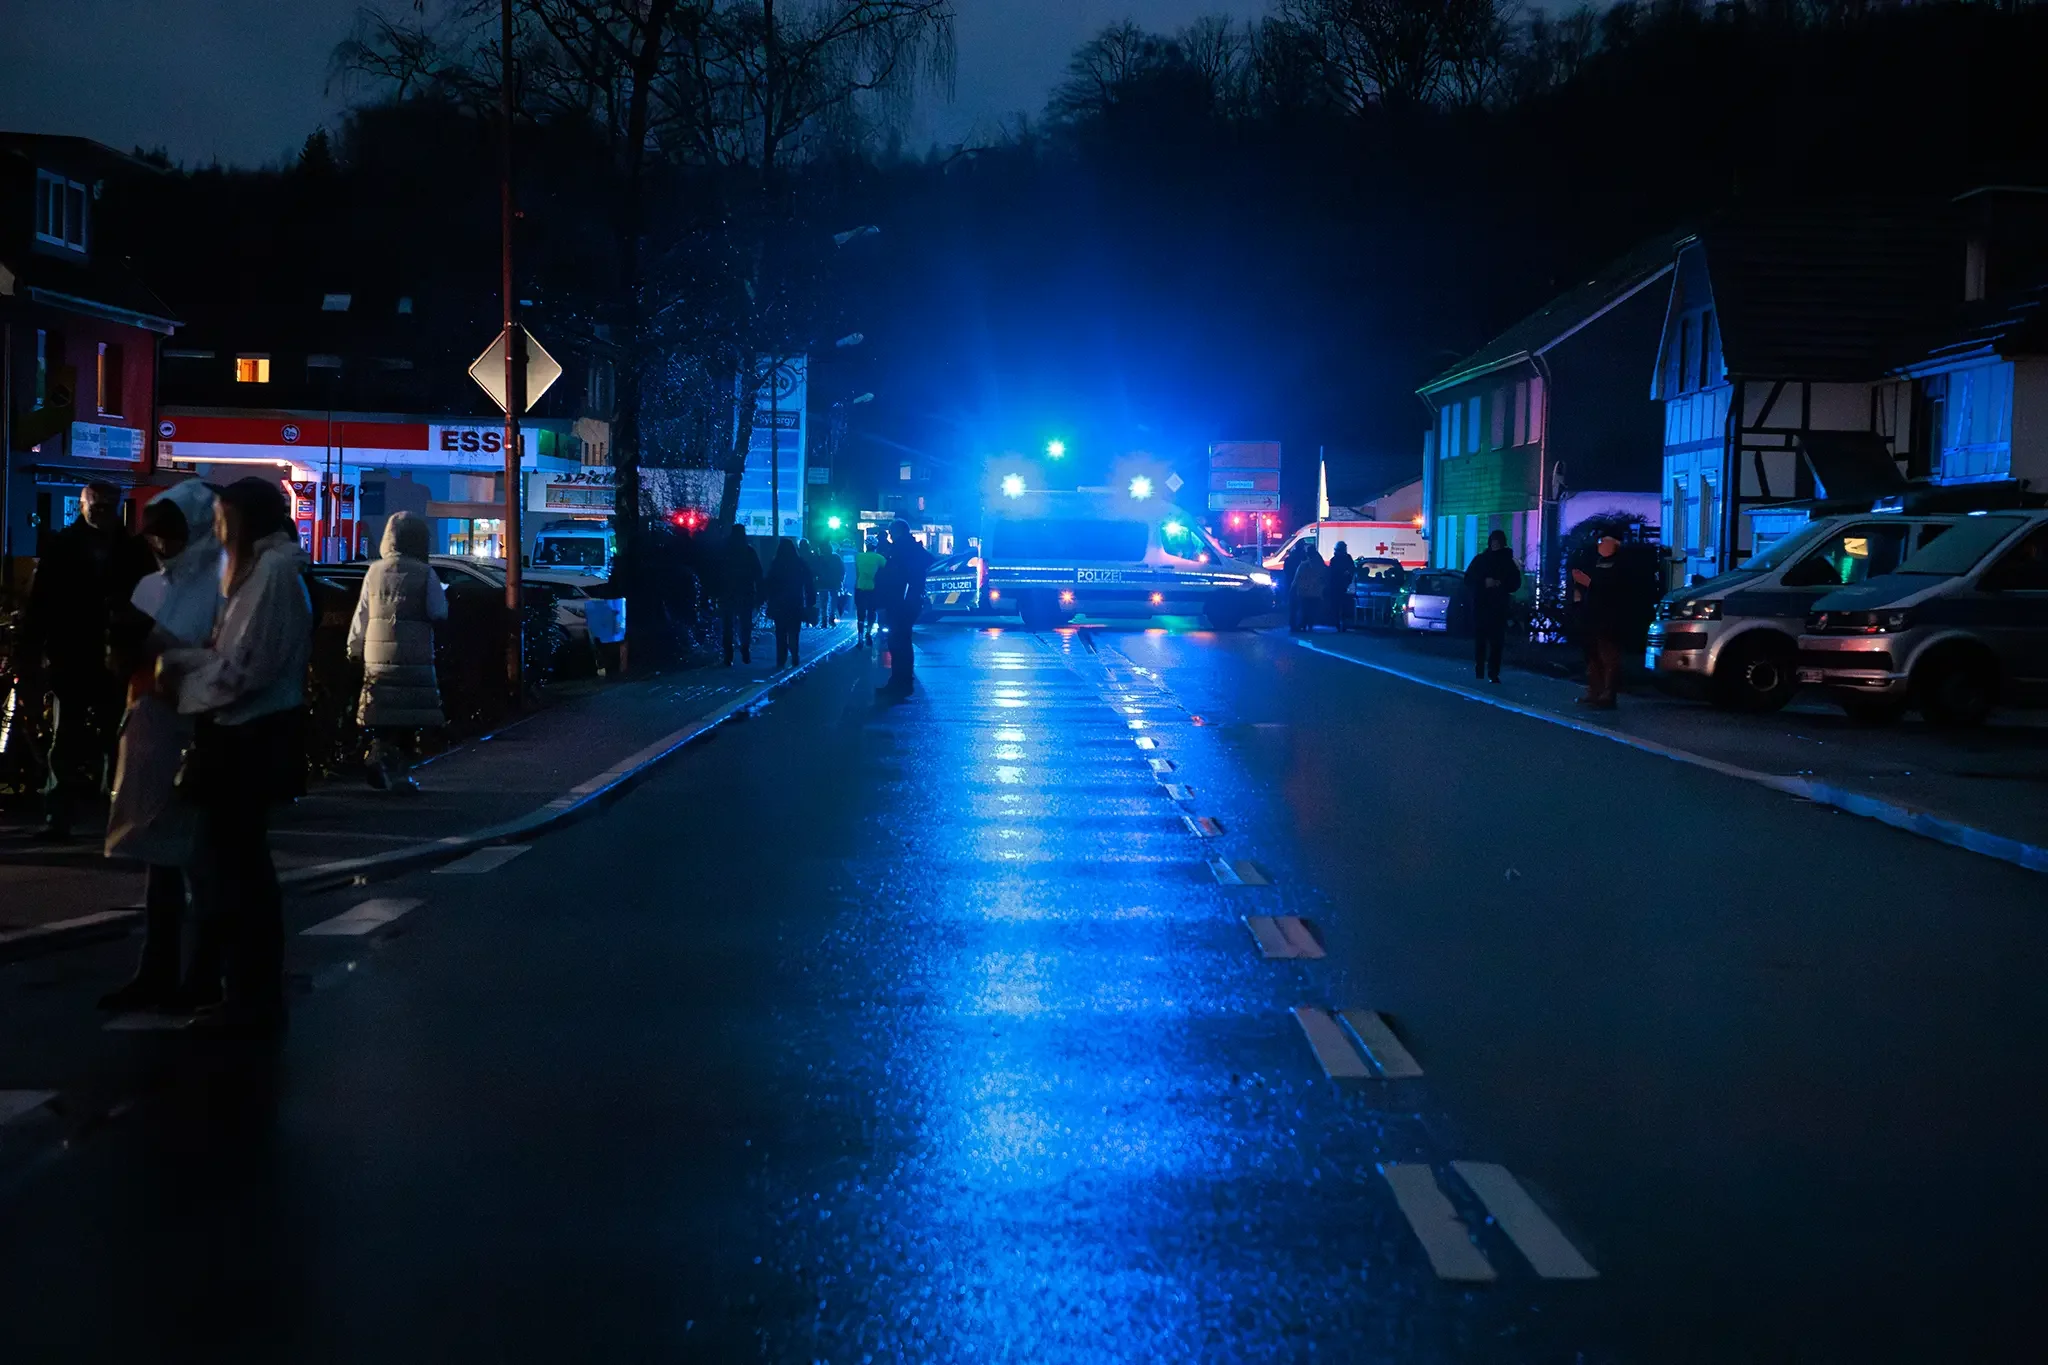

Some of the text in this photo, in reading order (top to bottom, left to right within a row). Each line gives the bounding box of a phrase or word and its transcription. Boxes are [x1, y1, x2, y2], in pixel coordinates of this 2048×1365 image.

[440, 431, 504, 452] ESS
[1077, 571, 1122, 582] POLIZEI
[941, 581, 972, 590] POLIZEI
